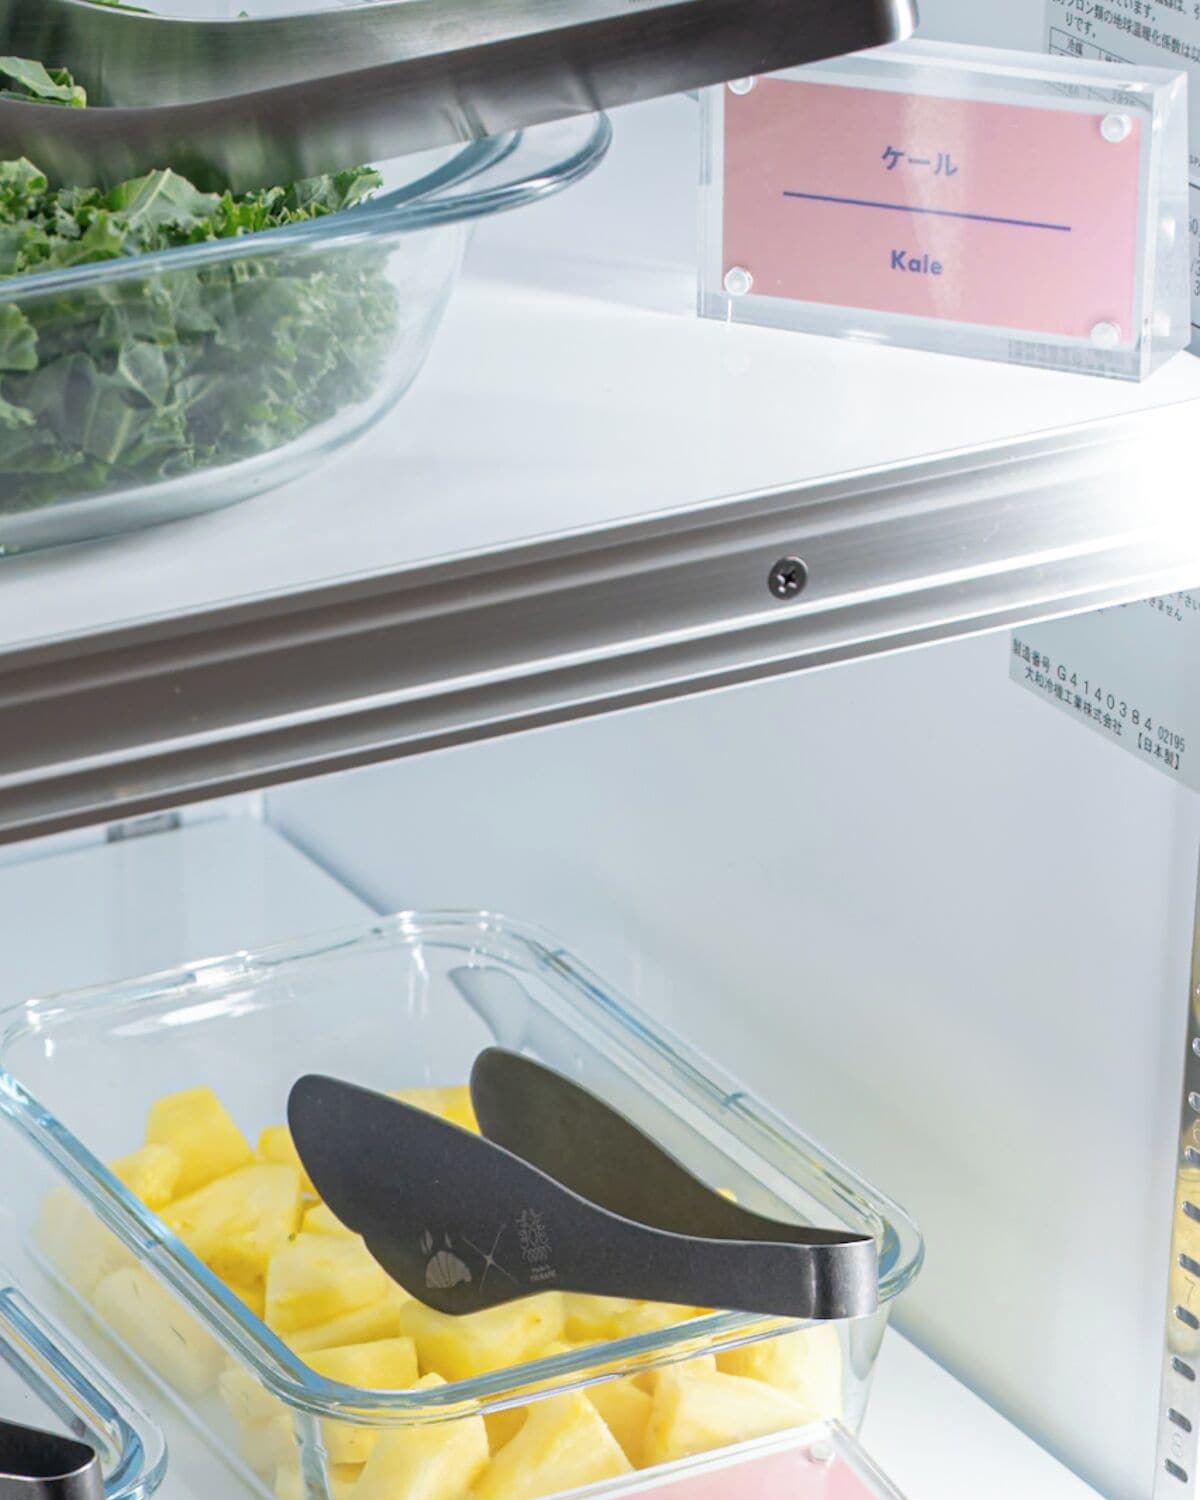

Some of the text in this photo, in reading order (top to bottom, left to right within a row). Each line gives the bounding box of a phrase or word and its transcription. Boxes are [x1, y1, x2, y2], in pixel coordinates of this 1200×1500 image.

[881, 145, 958, 176] ケール
[891, 249, 943, 275] Kale
[1013, 638, 1050, 673] 製造番号
